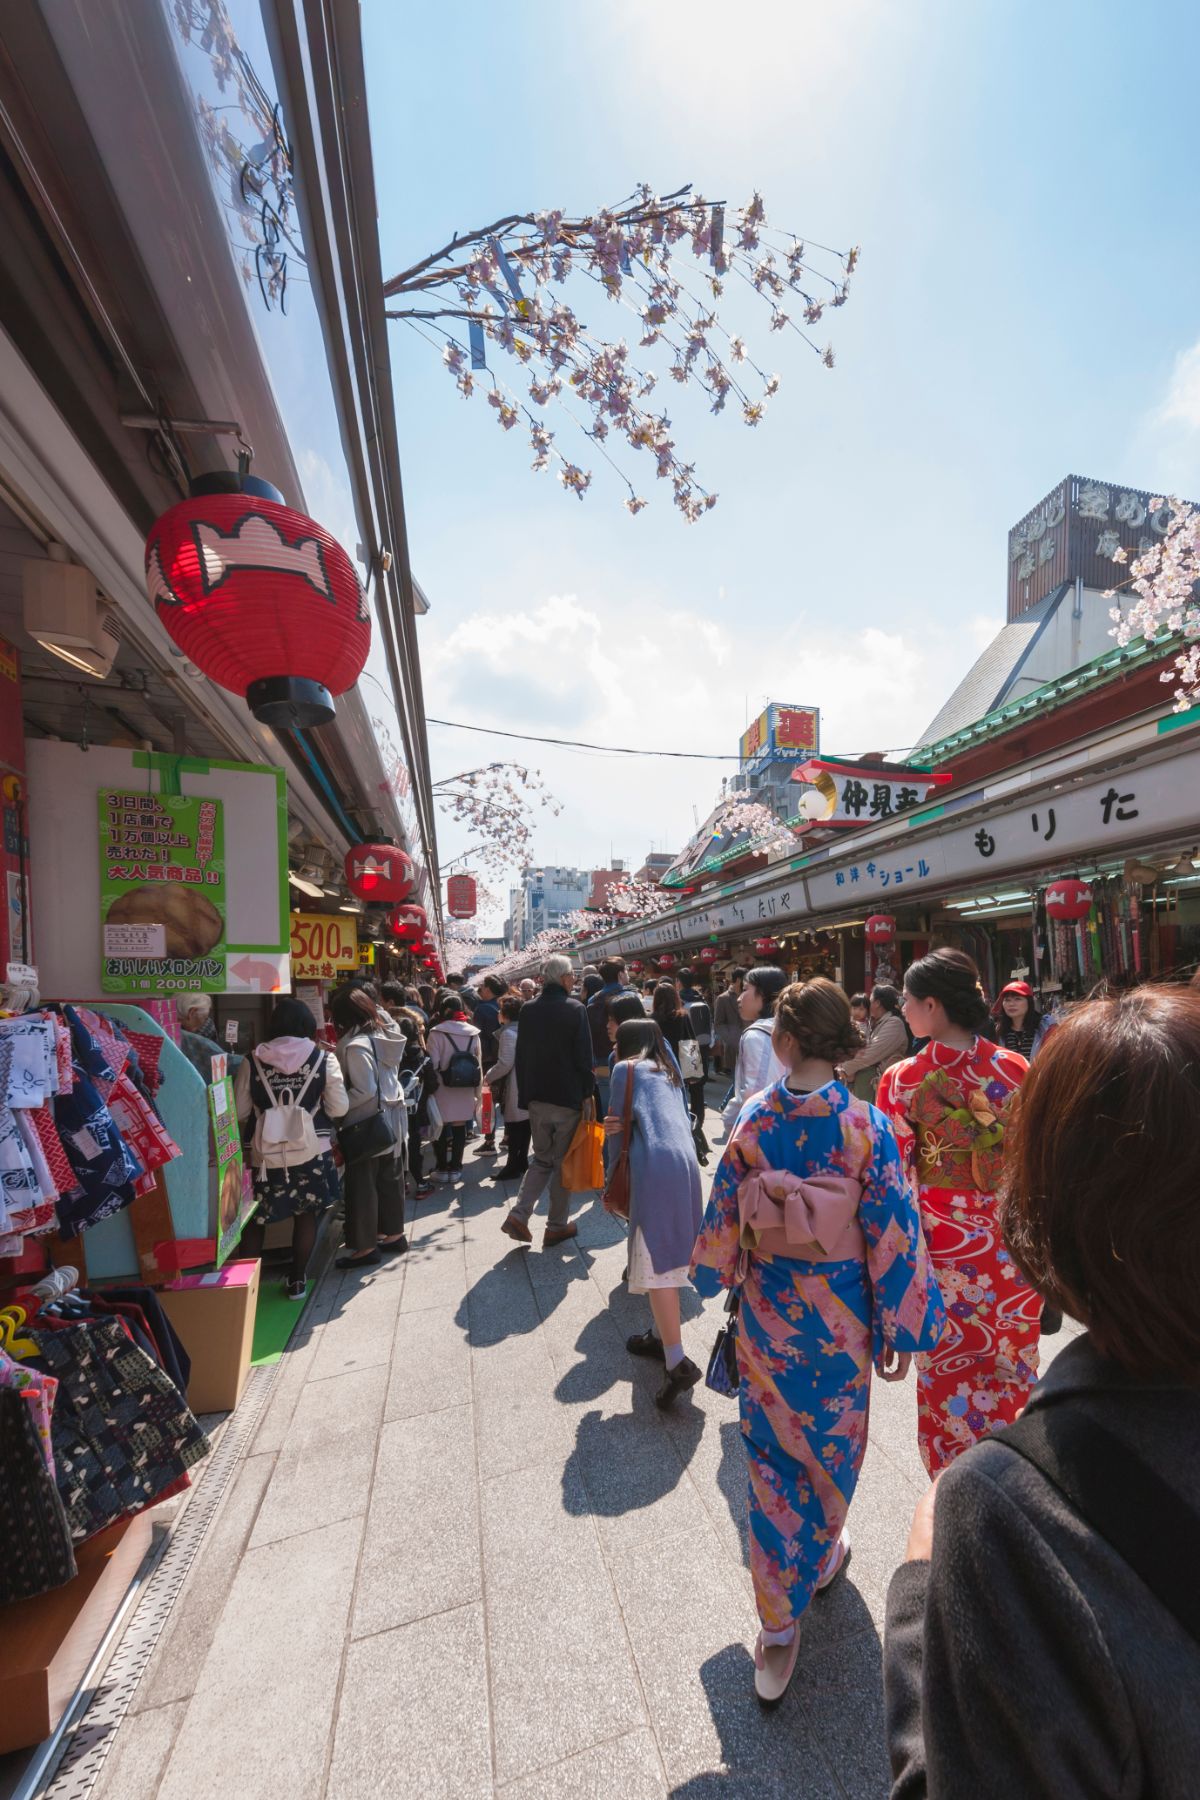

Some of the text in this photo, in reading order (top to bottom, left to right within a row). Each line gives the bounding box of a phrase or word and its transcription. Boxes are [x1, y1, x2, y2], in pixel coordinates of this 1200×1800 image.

[777, 709, 815, 747] 薬
[107, 795, 164, 812] 3日間、
[108, 812, 173, 829] 1店舗で
[974, 787, 1139, 858] もりた
[109, 829, 189, 847] 1万個以上
[107, 846, 168, 861] 売れた！
[290, 919, 353, 960] 500円
[107, 959, 224, 977] おいしいメロンパン
[156, 979, 202, 990] 200円
